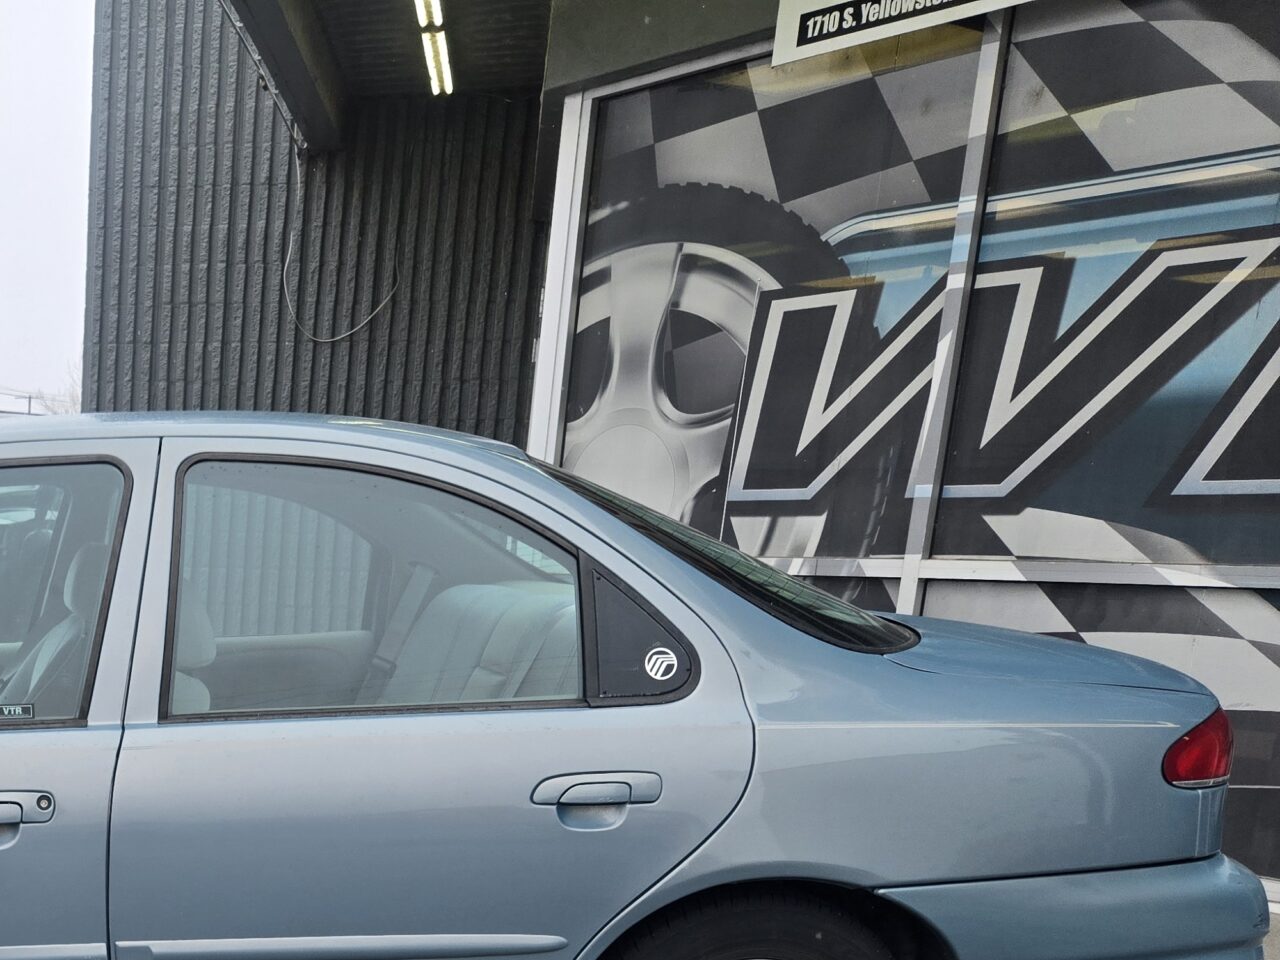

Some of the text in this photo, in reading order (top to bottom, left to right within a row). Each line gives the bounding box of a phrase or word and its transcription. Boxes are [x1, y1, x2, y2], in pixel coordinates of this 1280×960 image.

[806, 0, 953, 38] 1710 S. Yellows
[2, 706, 22, 715] VTR
